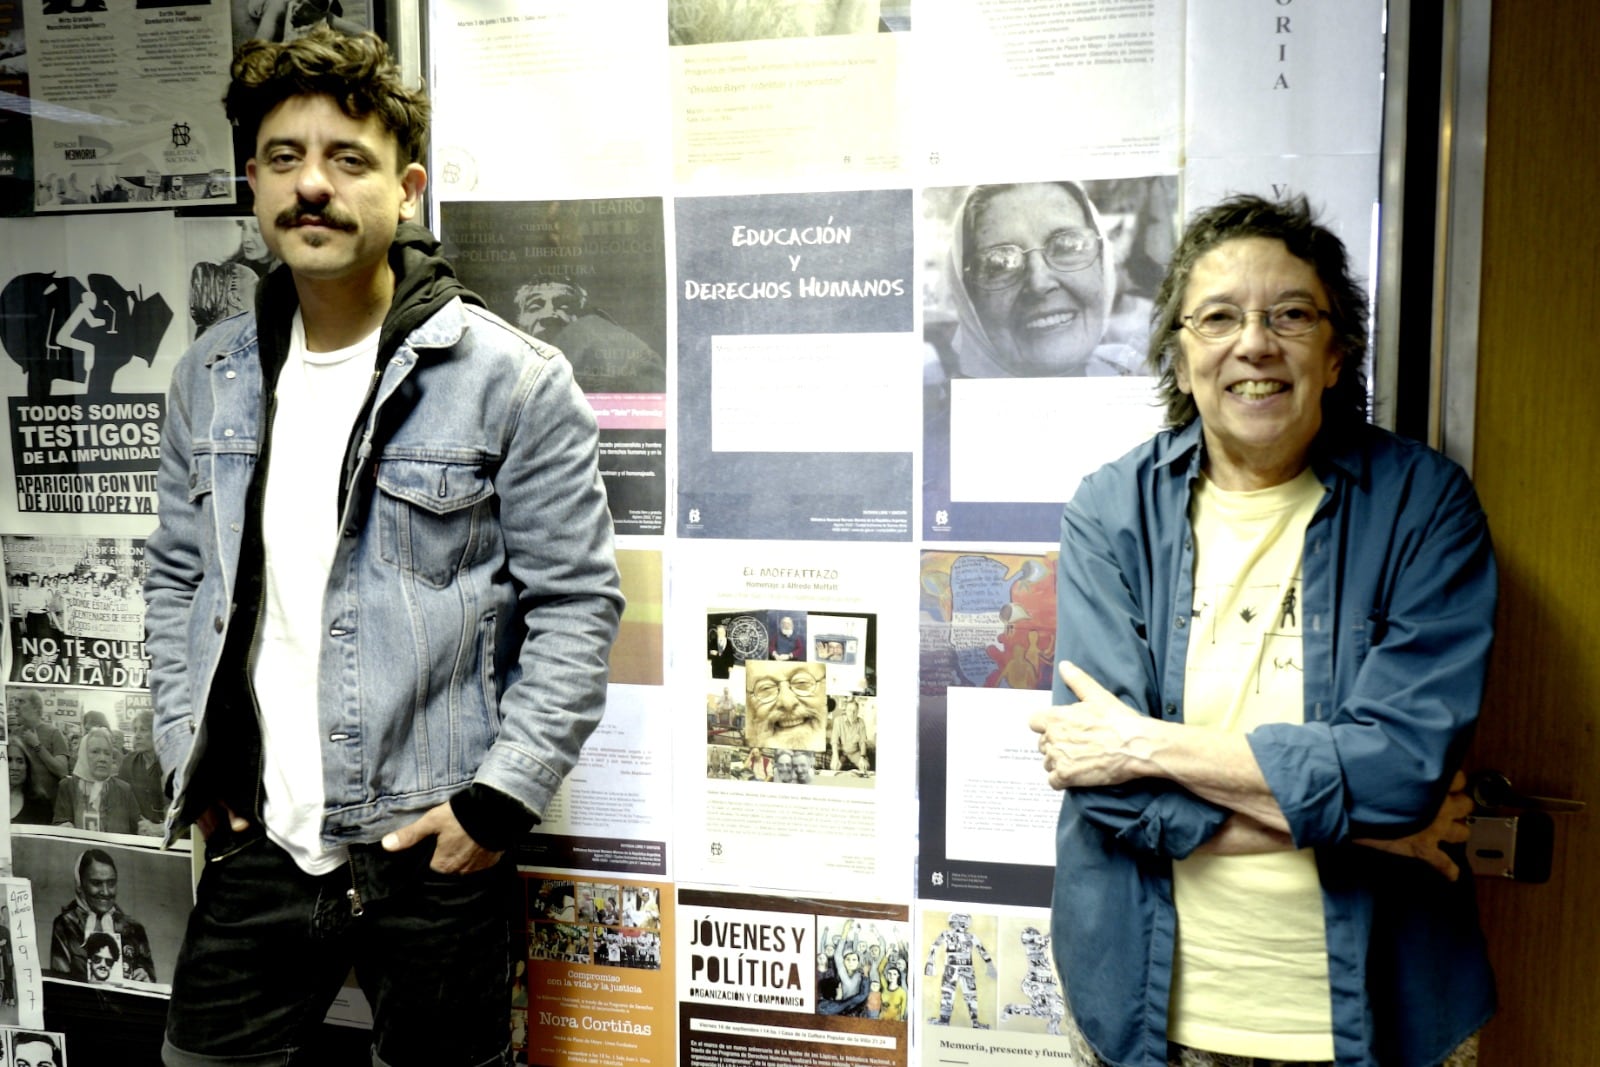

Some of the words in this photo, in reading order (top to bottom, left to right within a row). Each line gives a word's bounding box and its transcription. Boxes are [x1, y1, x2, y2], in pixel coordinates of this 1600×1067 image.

[590, 199, 646, 215] TEATRO
[732, 215, 851, 247] EDUCACIÓN
[685, 280, 792, 300] DERECHOS
[799, 276, 905, 298] HUMANOS
[17, 404, 83, 422] TODOS
[88, 403, 161, 421] SOMOS
[18, 422, 161, 448] TESTIGOS
[23, 451, 45, 465] DE
[48, 450, 68, 464] LA
[72, 446, 161, 463] IMPUNIDAD
[98, 474, 131, 494] CON
[133, 474, 158, 493] VID
[25, 493, 41, 511] DE
[44, 493, 84, 513] JULIO
[88, 491, 132, 513] LÓPEZ
[134, 496, 153, 513] YA
[22, 637, 58, 656] NO
[63, 639, 86, 657] TE
[21, 663, 71, 683] CON
[79, 666, 105, 686] LA
[112, 667, 151, 687] DU
[690, 915, 786, 953] JÓVENES
[791, 926, 806, 954] Y
[567, 970, 621, 983] Compromiso
[691, 953, 802, 991] POLÍTICA
[547, 977, 562, 986] con
[564, 978, 572, 987] la
[573, 980, 592, 989] vida
[592, 983, 600, 992] y
[601, 982, 609, 991] la
[609, 982, 643, 995] justicia
[689, 986, 745, 1003] ORGANIZACIÓN
[746, 992, 751, 1003] Y
[753, 993, 805, 1008] COMPROMISO
[538, 1010, 579, 1029] Nora
[582, 1015, 652, 1037] Cortiñas
[939, 1039, 988, 1053] Memoria,
[989, 1046, 1033, 1059] presente
[1034, 1051, 1040, 1059] y
